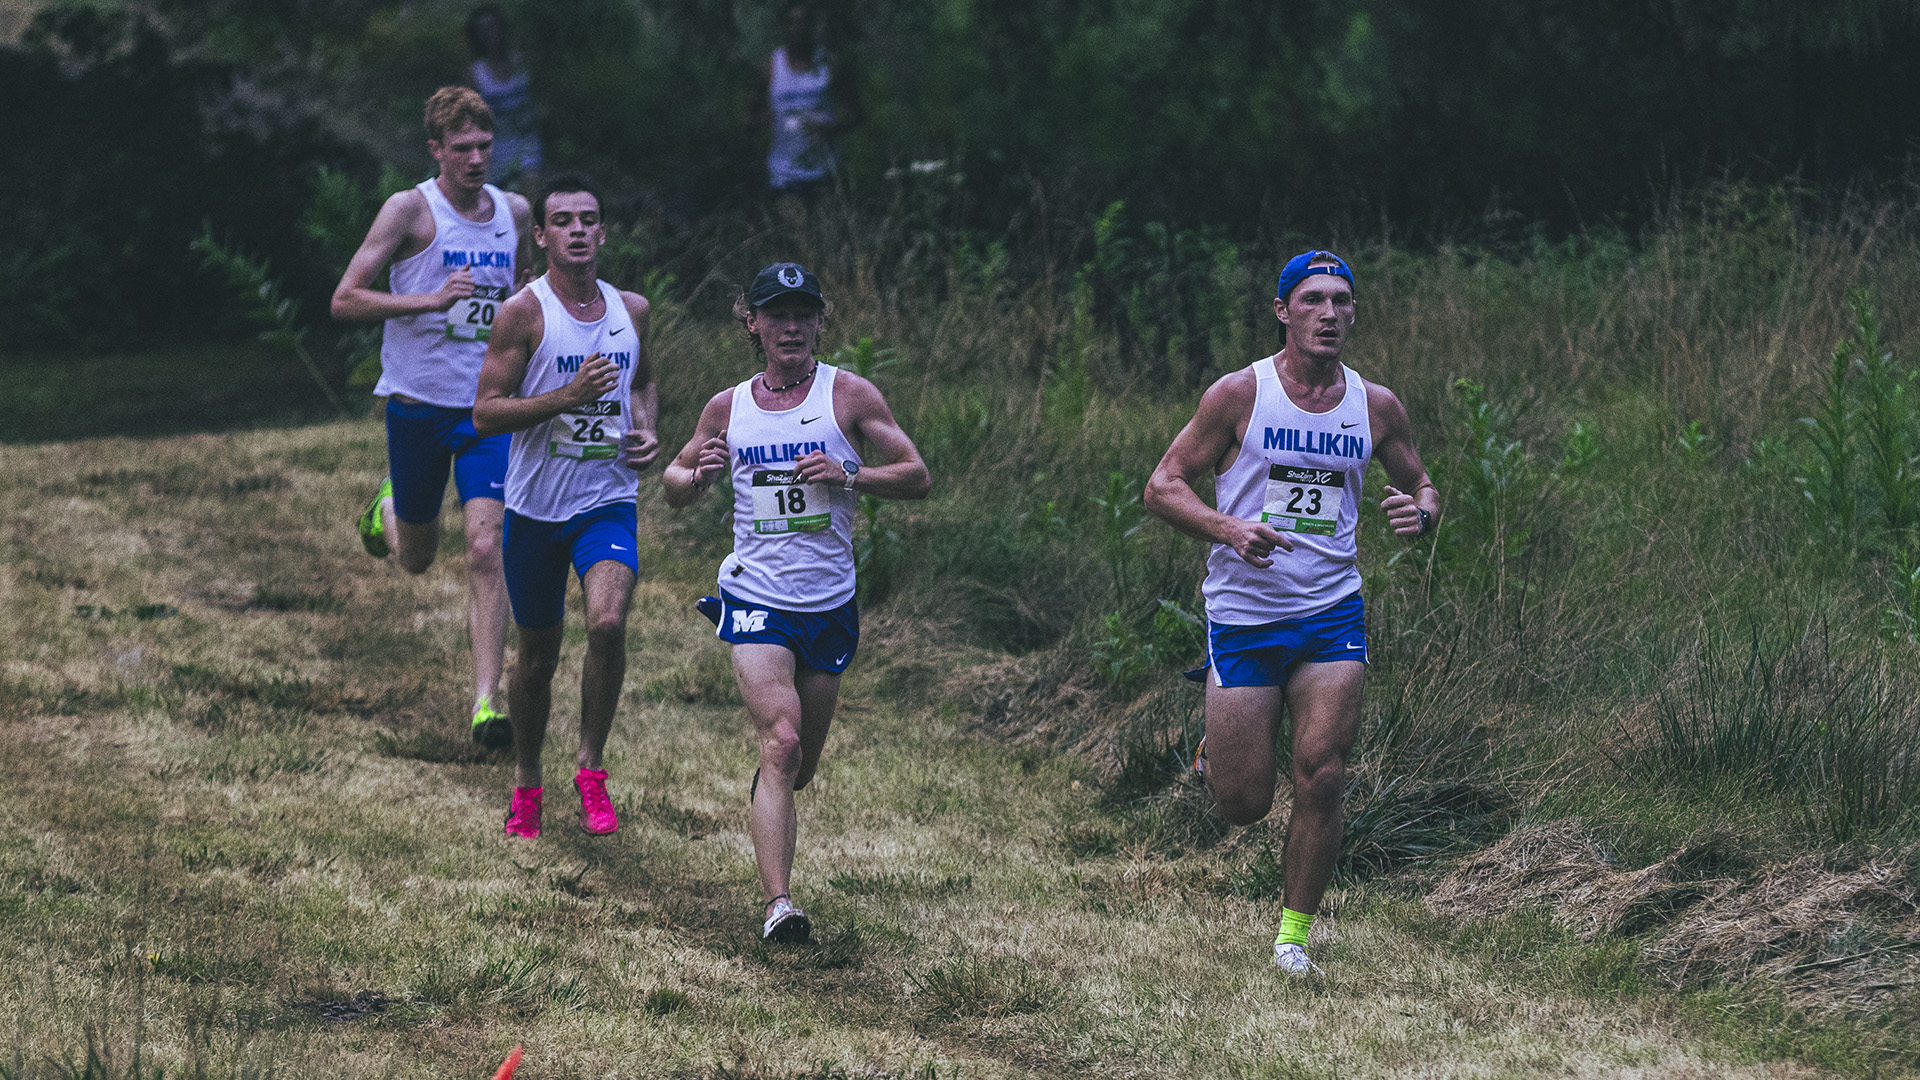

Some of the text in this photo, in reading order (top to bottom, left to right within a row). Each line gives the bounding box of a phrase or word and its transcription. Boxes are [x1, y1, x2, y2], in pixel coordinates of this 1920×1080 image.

[466, 301, 495, 326] 20
[572, 418, 605, 442] 26
[1263, 427, 1364, 459] MILLIKIN
[1312, 470, 1333, 484] XC
[774, 487, 806, 515] 18
[1286, 486, 1322, 516] 23
